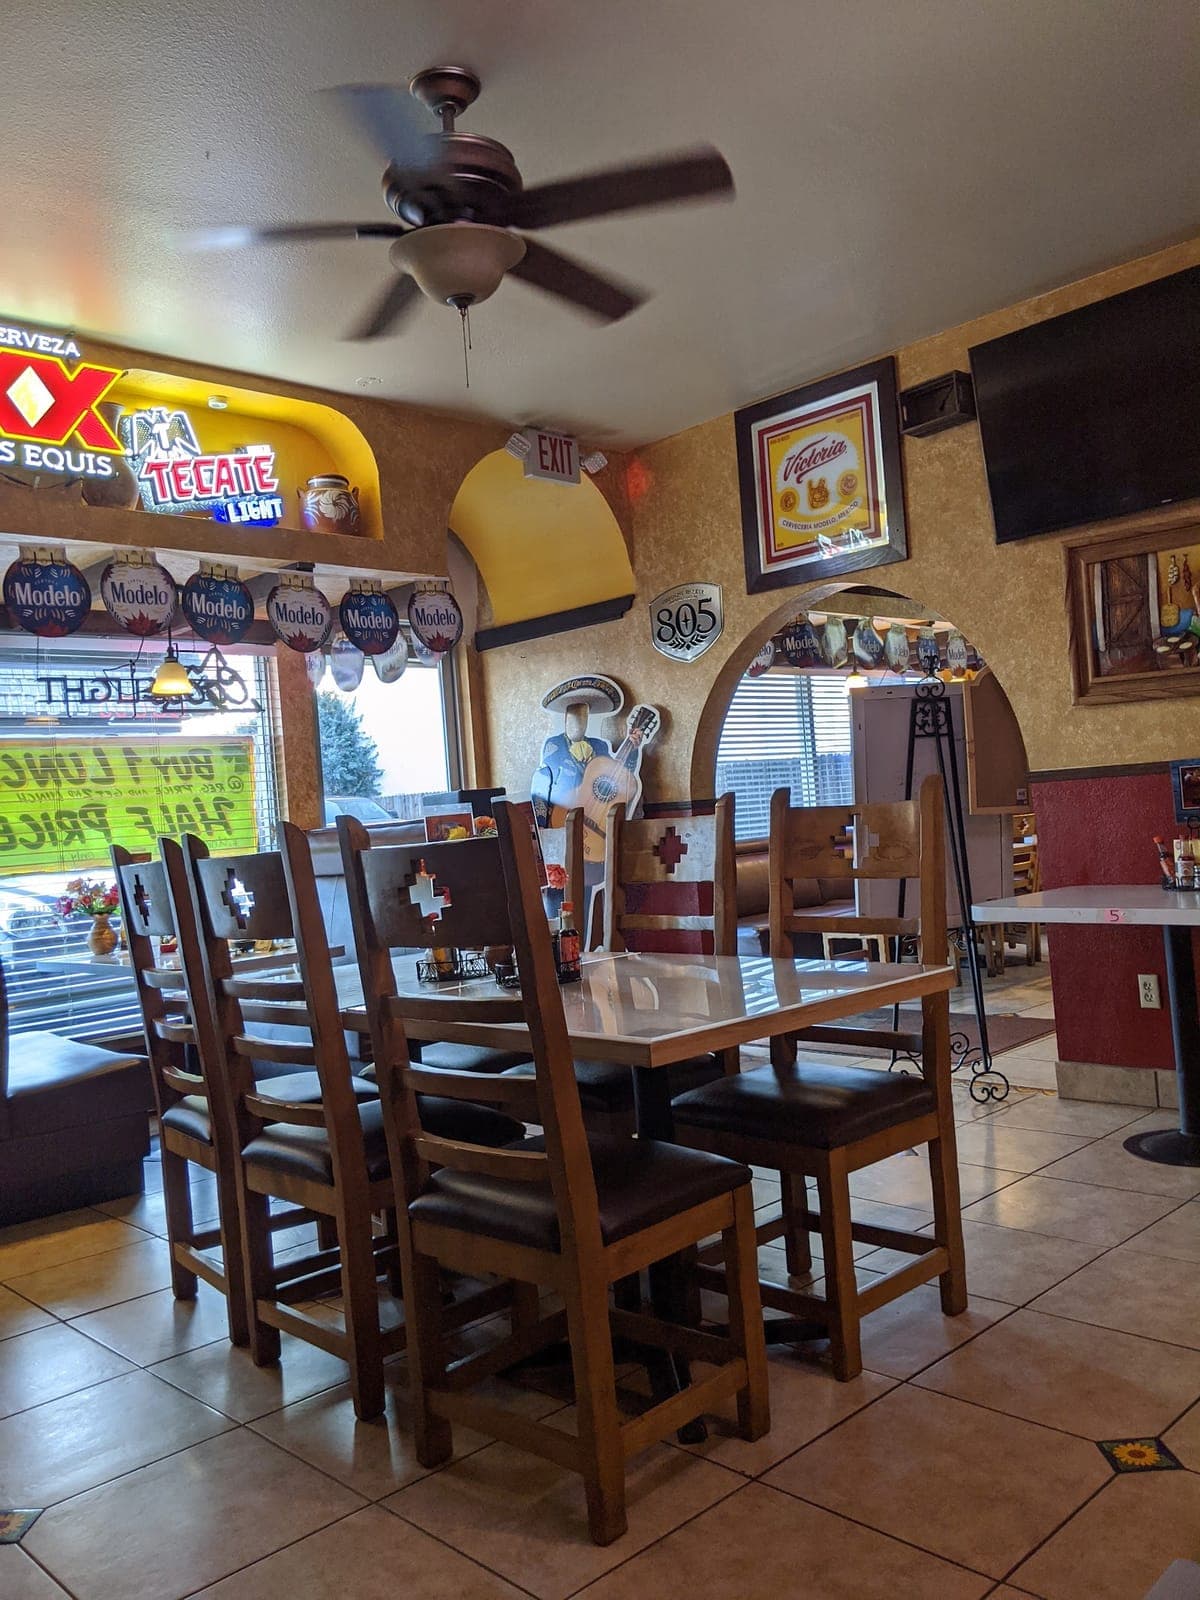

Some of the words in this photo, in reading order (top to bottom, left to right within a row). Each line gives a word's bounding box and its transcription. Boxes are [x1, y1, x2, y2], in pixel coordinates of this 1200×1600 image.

[24, 444, 113, 476] EQUIS
[538, 434, 573, 475] EXIT
[783, 435, 848, 484] Victoria
[141, 453, 278, 502] TECATE
[227, 498, 282, 523] LIGHT
[15, 582, 81, 607] Modelo
[111, 581, 168, 606] Modelo
[192, 592, 246, 620] Modelo
[275, 602, 324, 626] Modelo
[347, 608, 393, 630] Modelo
[415, 607, 456, 626] Modelo
[657, 597, 716, 642] 805
[1110, 909, 1120, 922] 5
